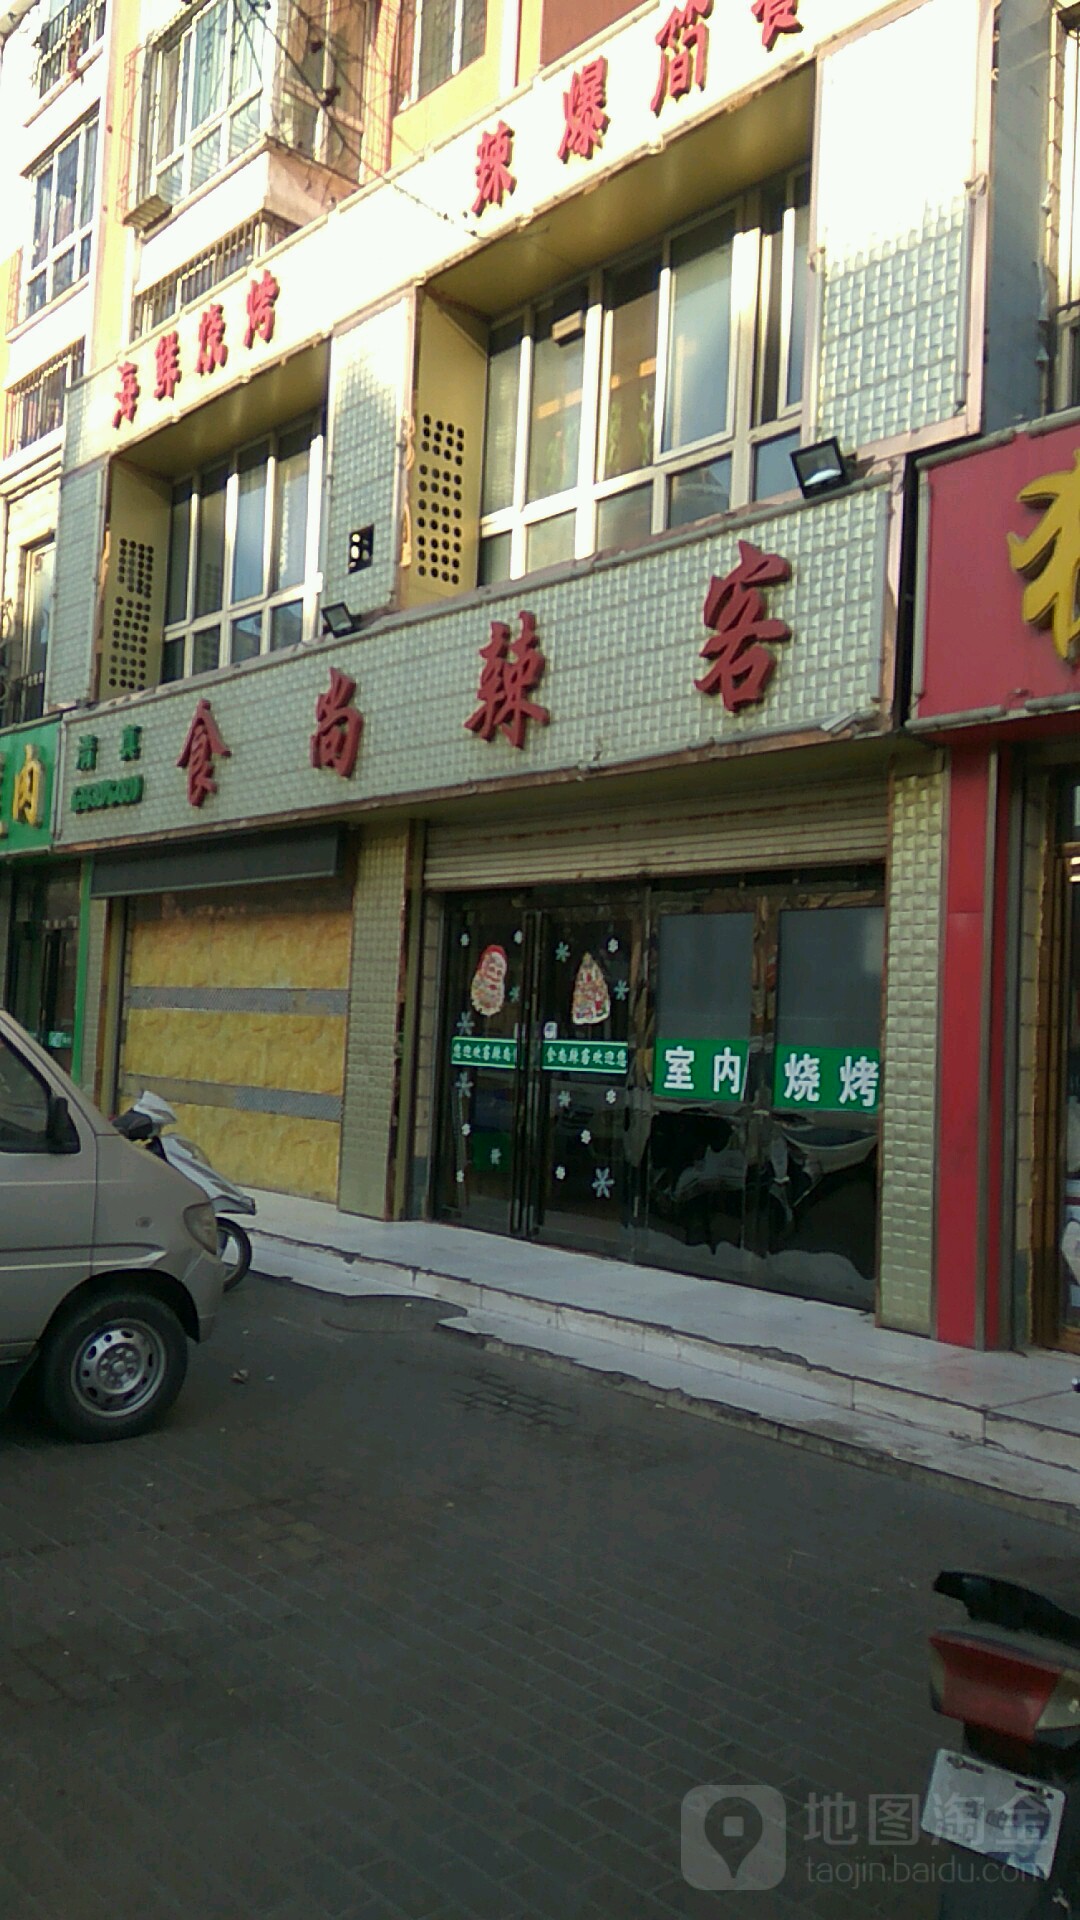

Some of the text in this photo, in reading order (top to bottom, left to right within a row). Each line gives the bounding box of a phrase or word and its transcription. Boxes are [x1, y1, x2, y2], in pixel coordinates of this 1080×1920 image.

[176, 539, 793, 808] 食尚辣客
[663, 1045, 880, 1107] 室内 烧烤
